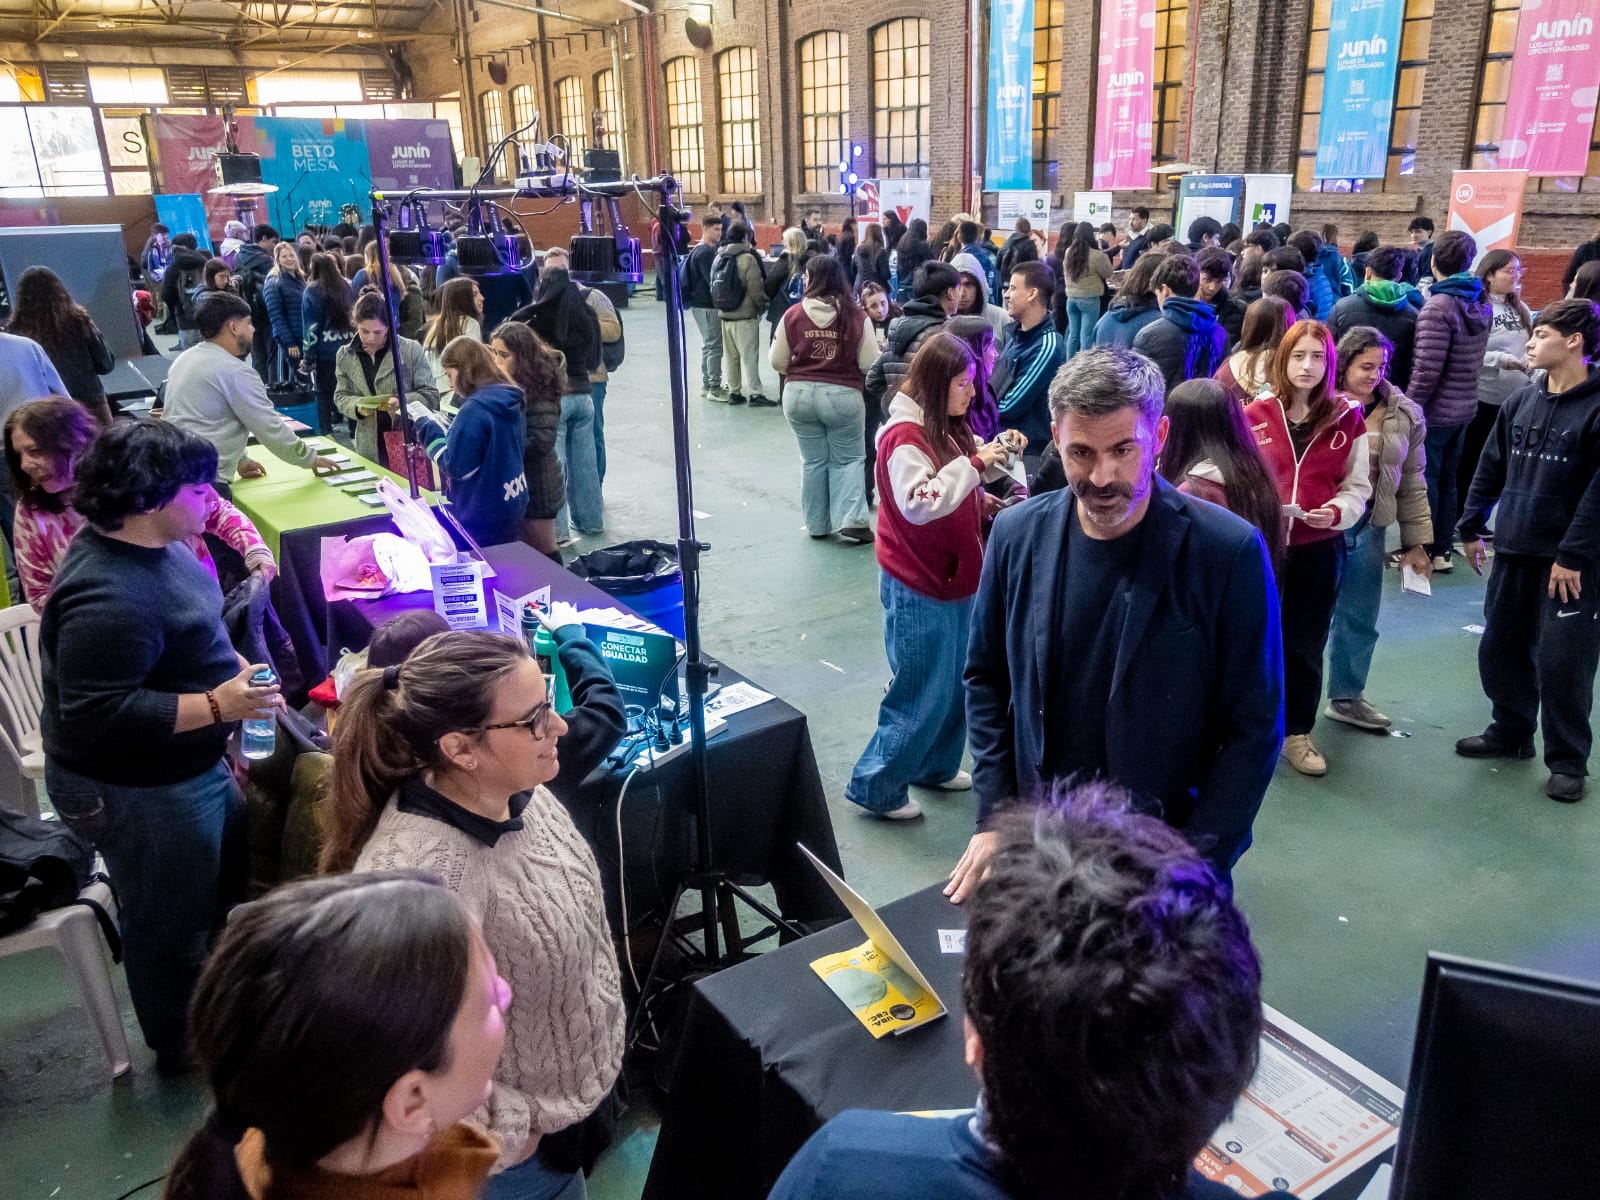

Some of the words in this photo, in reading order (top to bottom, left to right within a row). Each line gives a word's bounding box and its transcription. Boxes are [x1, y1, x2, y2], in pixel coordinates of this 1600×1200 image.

[1528, 44, 1590, 55] OPORTUNIDADES
[292, 145, 335, 158] BETO
[294, 158, 339, 172] MESA
[810, 341, 836, 360] 26
[601, 641, 647, 655] CONECTAR
[602, 650, 648, 663] IGUALDAD
